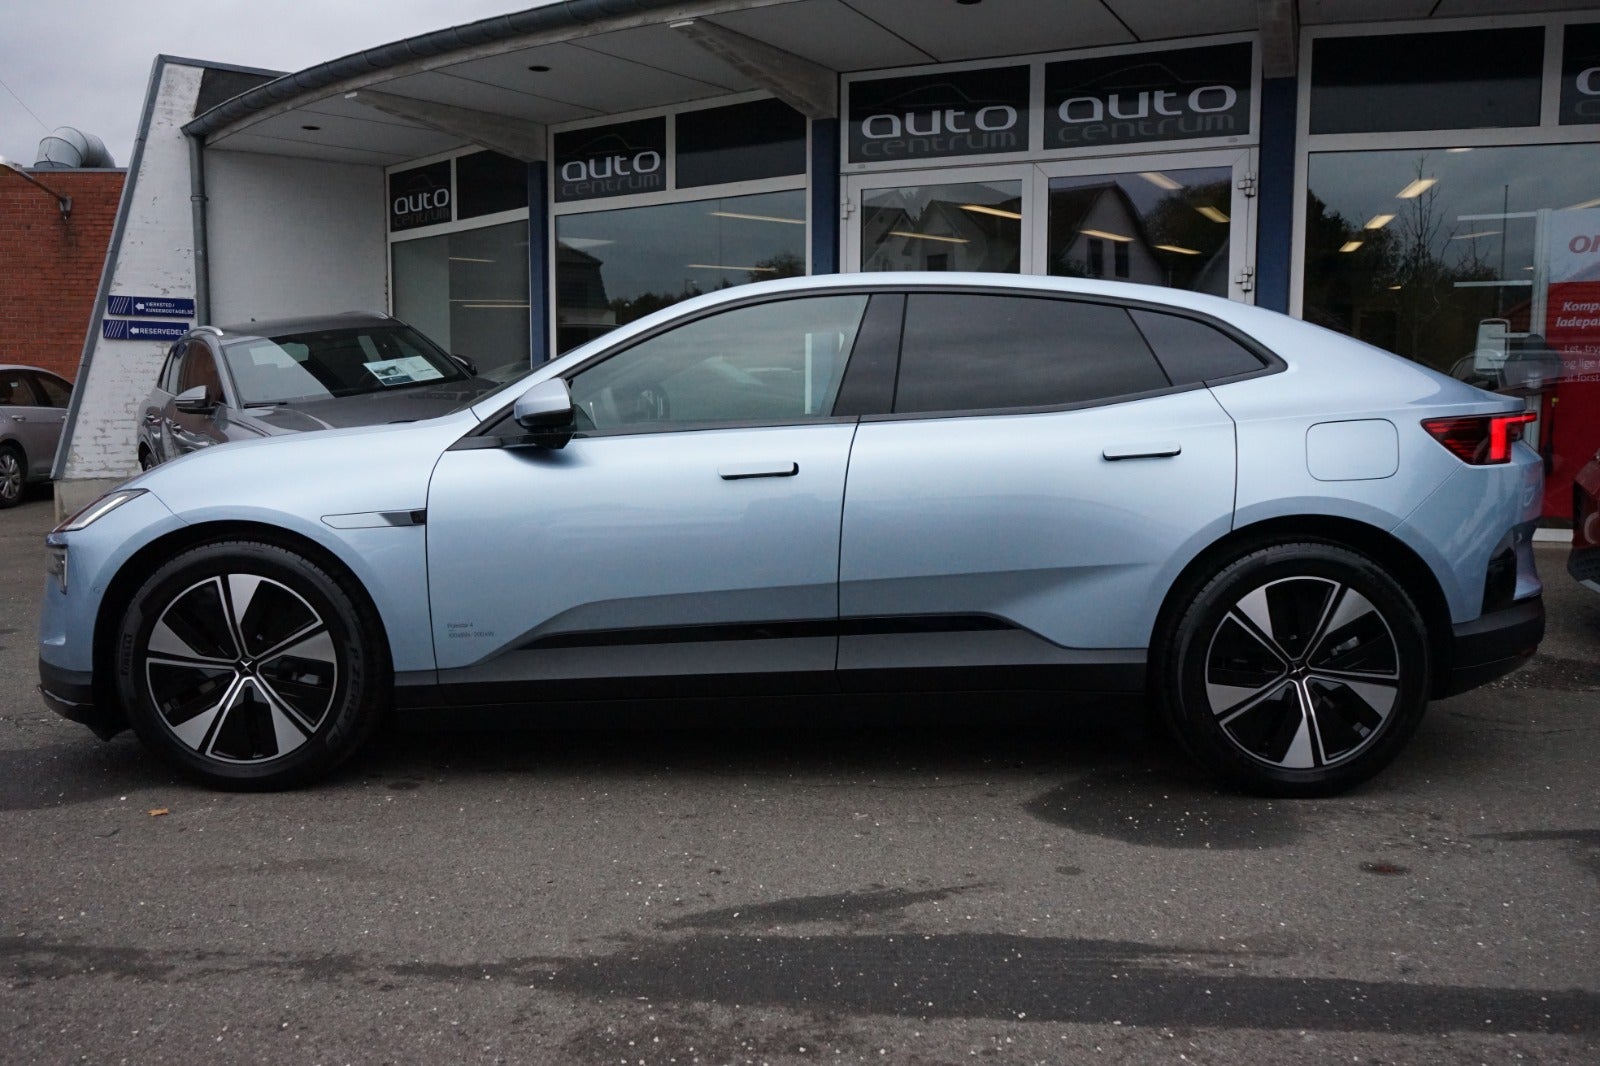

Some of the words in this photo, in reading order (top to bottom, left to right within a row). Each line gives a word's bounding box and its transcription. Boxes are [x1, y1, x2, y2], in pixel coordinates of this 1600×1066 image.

[1058, 85, 1237, 123] auto
[862, 105, 1018, 139] auto
[1058, 114, 1234, 142] centrum
[862, 132, 1016, 157] centrum
[561, 151, 661, 182] auto
[562, 174, 660, 196] centrum
[394, 188, 450, 215] auto
